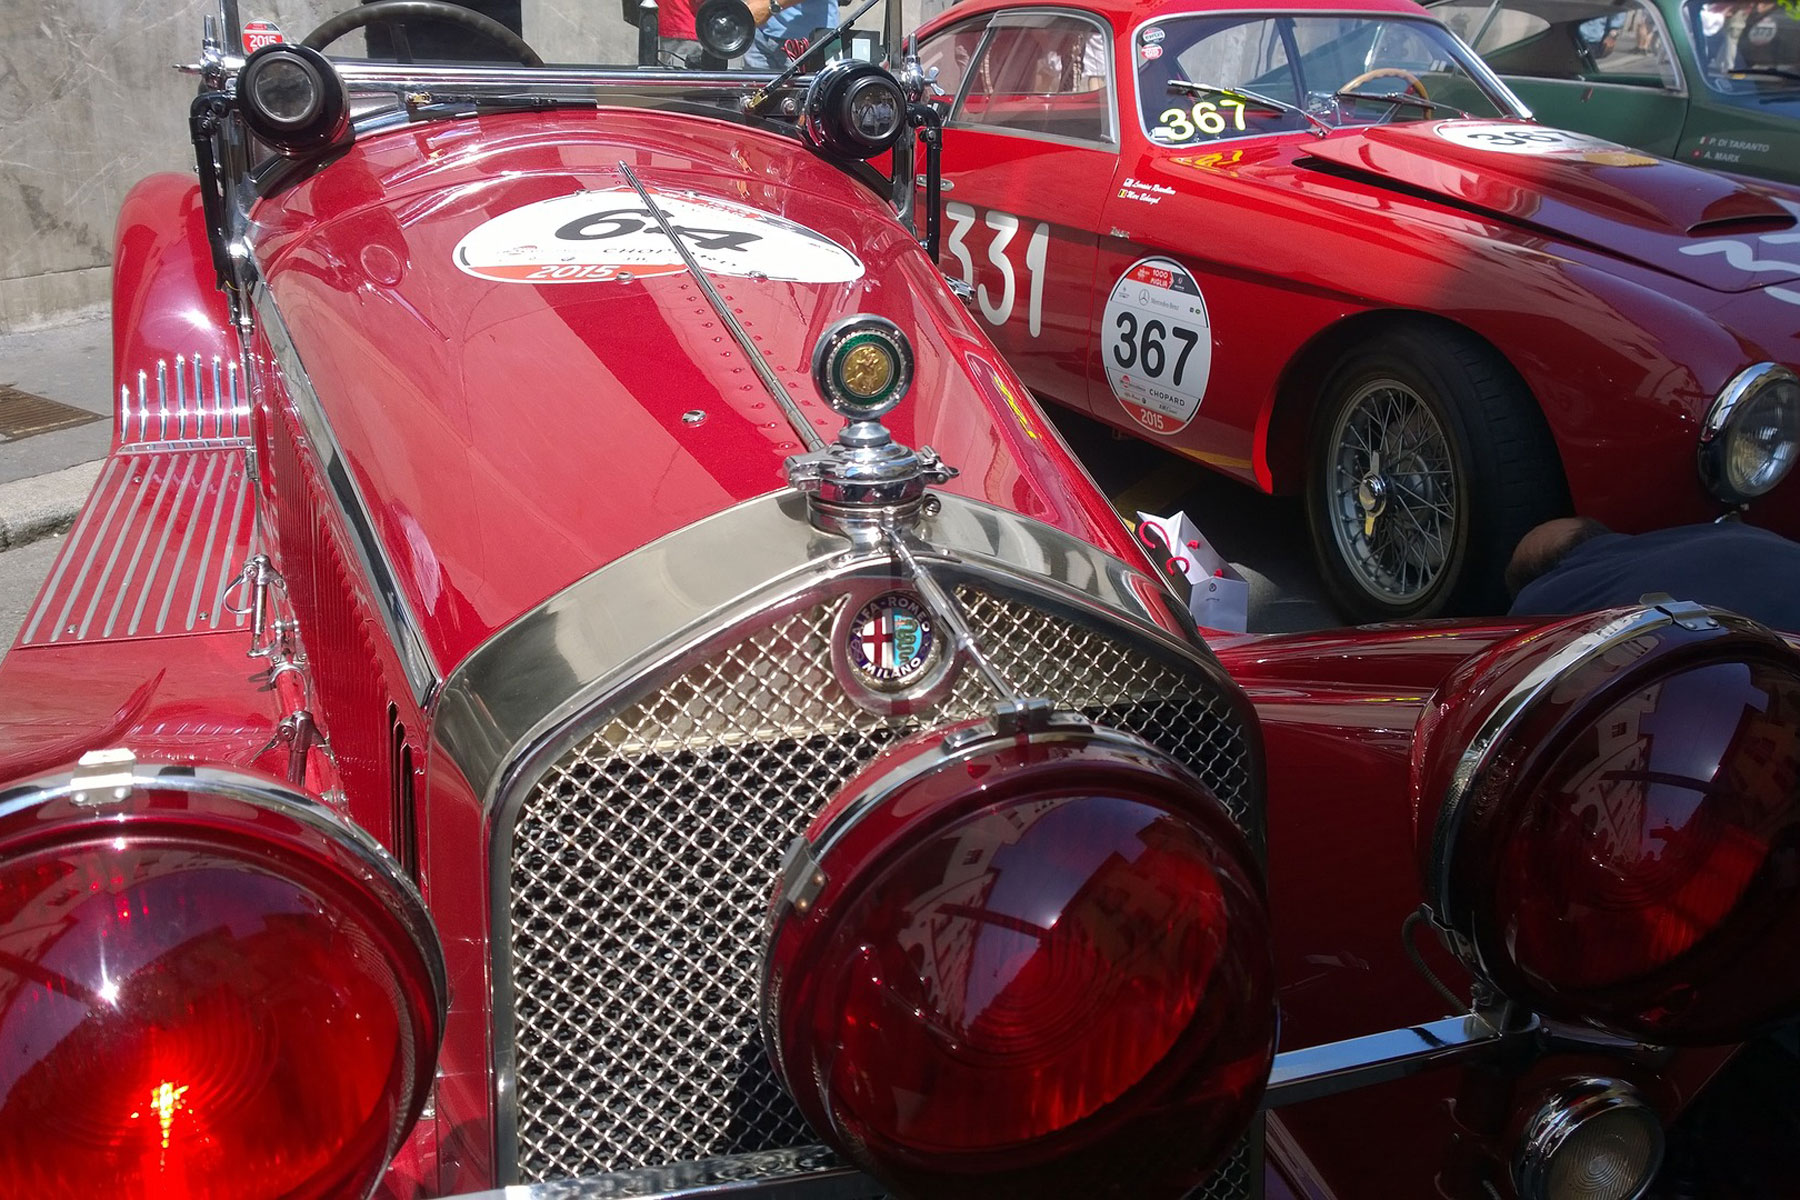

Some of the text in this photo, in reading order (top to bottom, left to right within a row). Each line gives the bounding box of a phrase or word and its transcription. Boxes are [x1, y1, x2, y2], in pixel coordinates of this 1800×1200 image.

[249, 34, 277, 48] 2015
[1160, 100, 1246, 140] 367
[1467, 130, 1588, 146] 367
[1729, 140, 1770, 153] TARANTO
[554, 208, 764, 252] 64
[525, 265, 621, 279] 2015
[945, 201, 1050, 338] 331
[1152, 269, 1169, 279] 1000
[1113, 311, 1199, 387] 367
[1149, 388, 1186, 407] CHOPARD
[1140, 408, 1164, 430] 2015
[862, 657, 922, 679] MILANO
